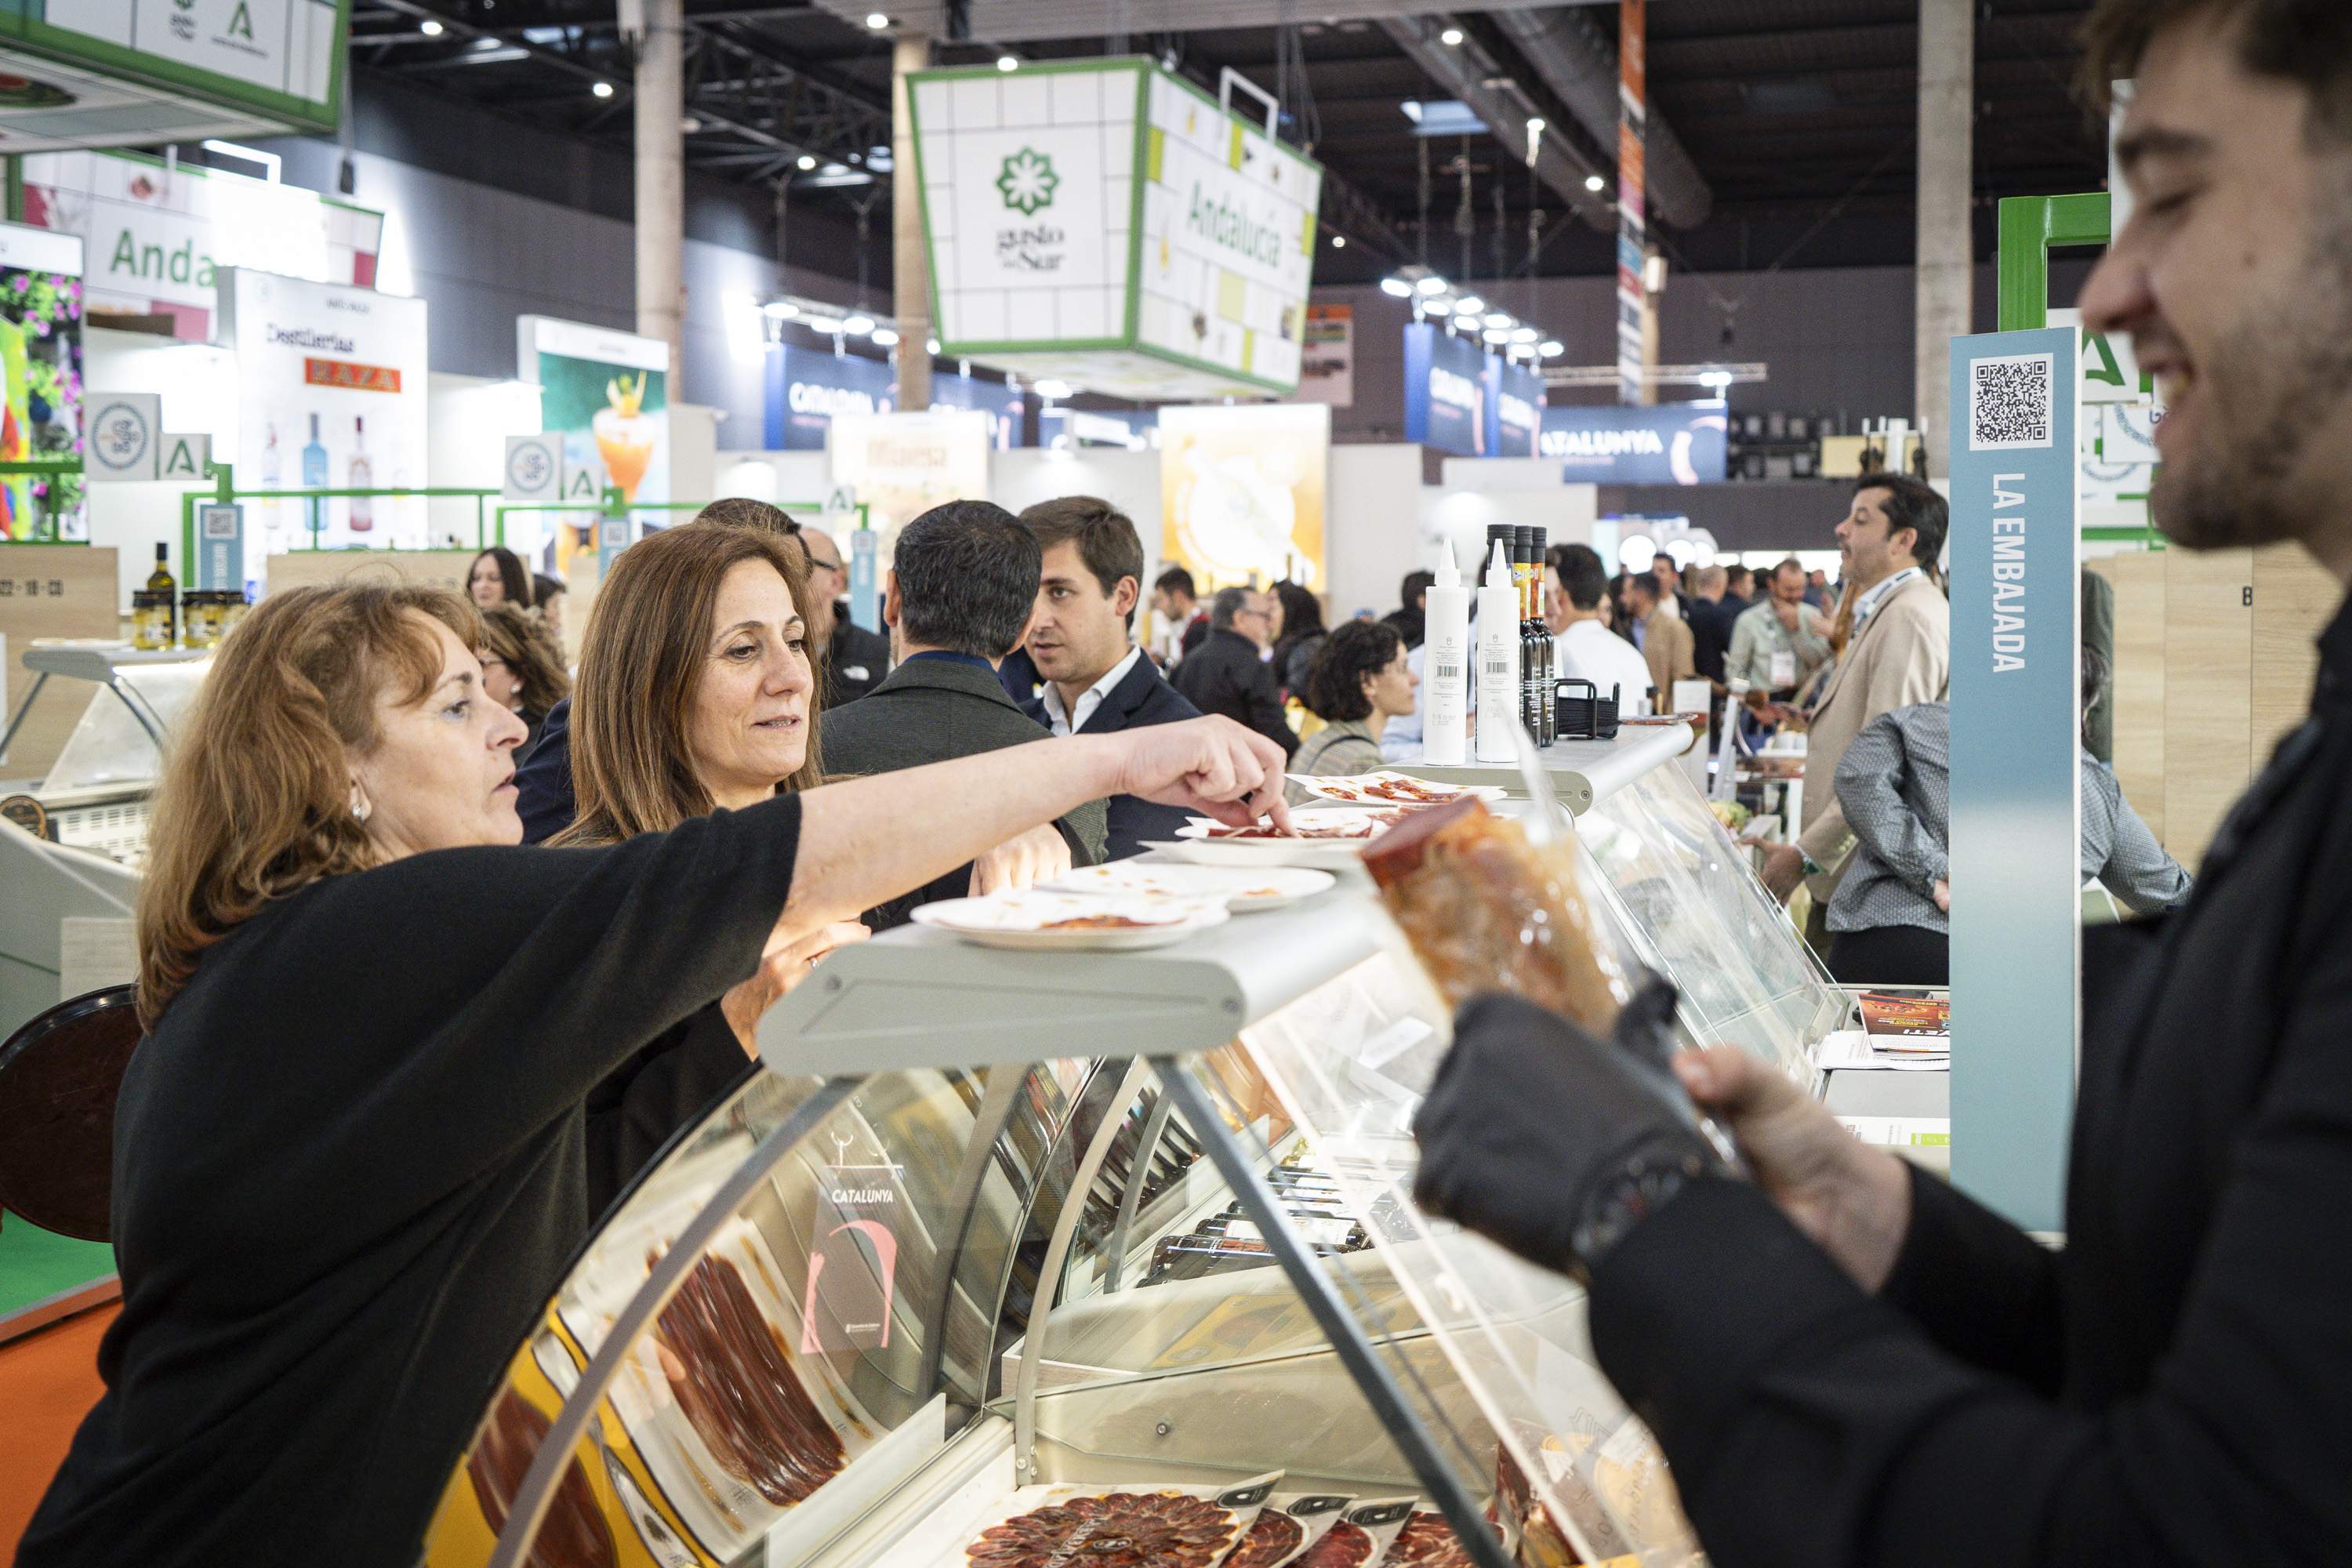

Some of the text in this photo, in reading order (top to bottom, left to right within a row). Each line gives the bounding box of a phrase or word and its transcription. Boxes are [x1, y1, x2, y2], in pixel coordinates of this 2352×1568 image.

[1186, 179, 1281, 268] Andalucía
[996, 223, 1065, 255] gusto
[1019, 251, 1065, 271] Sur
[1540, 430, 1664, 455] ATALUNYA
[1993, 474, 2025, 673] LA EMBAJADA
[832, 1189, 894, 1203] CATALUNYA
